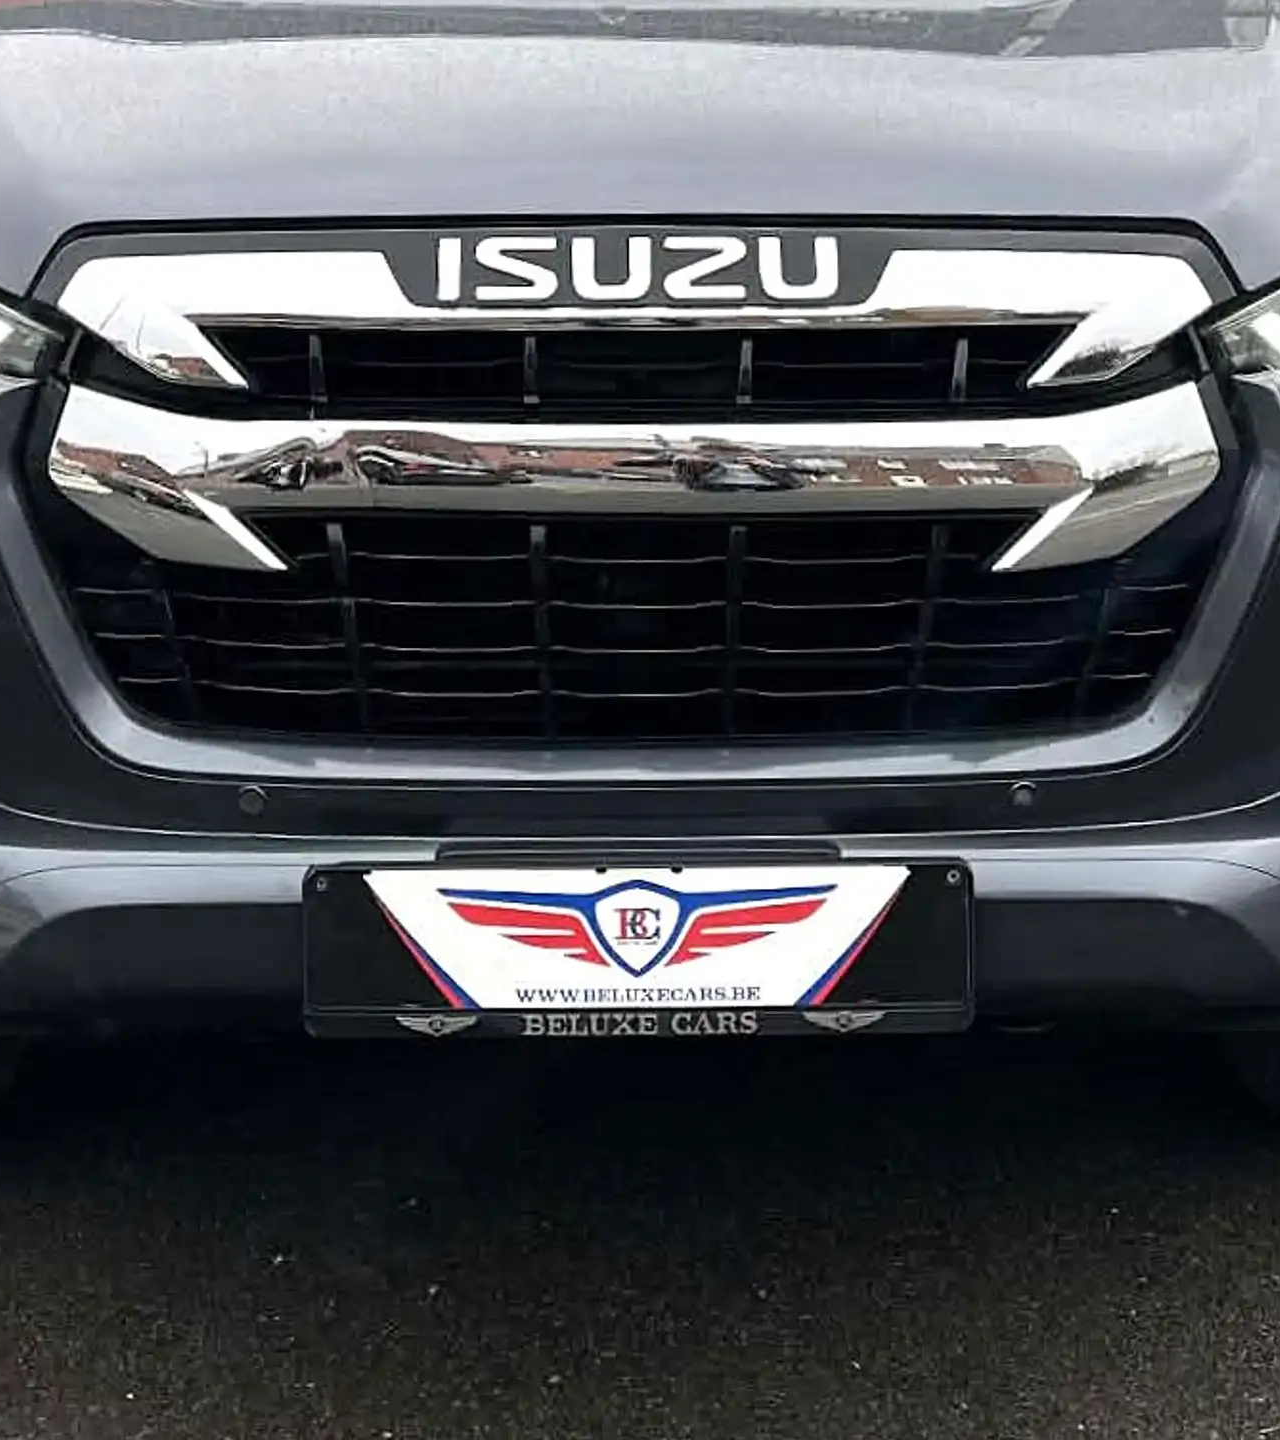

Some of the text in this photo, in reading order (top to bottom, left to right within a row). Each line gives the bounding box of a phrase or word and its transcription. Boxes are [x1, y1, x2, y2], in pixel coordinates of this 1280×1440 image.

[435, 235, 839, 302] ISUZU
[514, 986, 761, 1004] WWW.BELUXECARS.BE
[521, 1010, 759, 1036] BELUXE CARS
